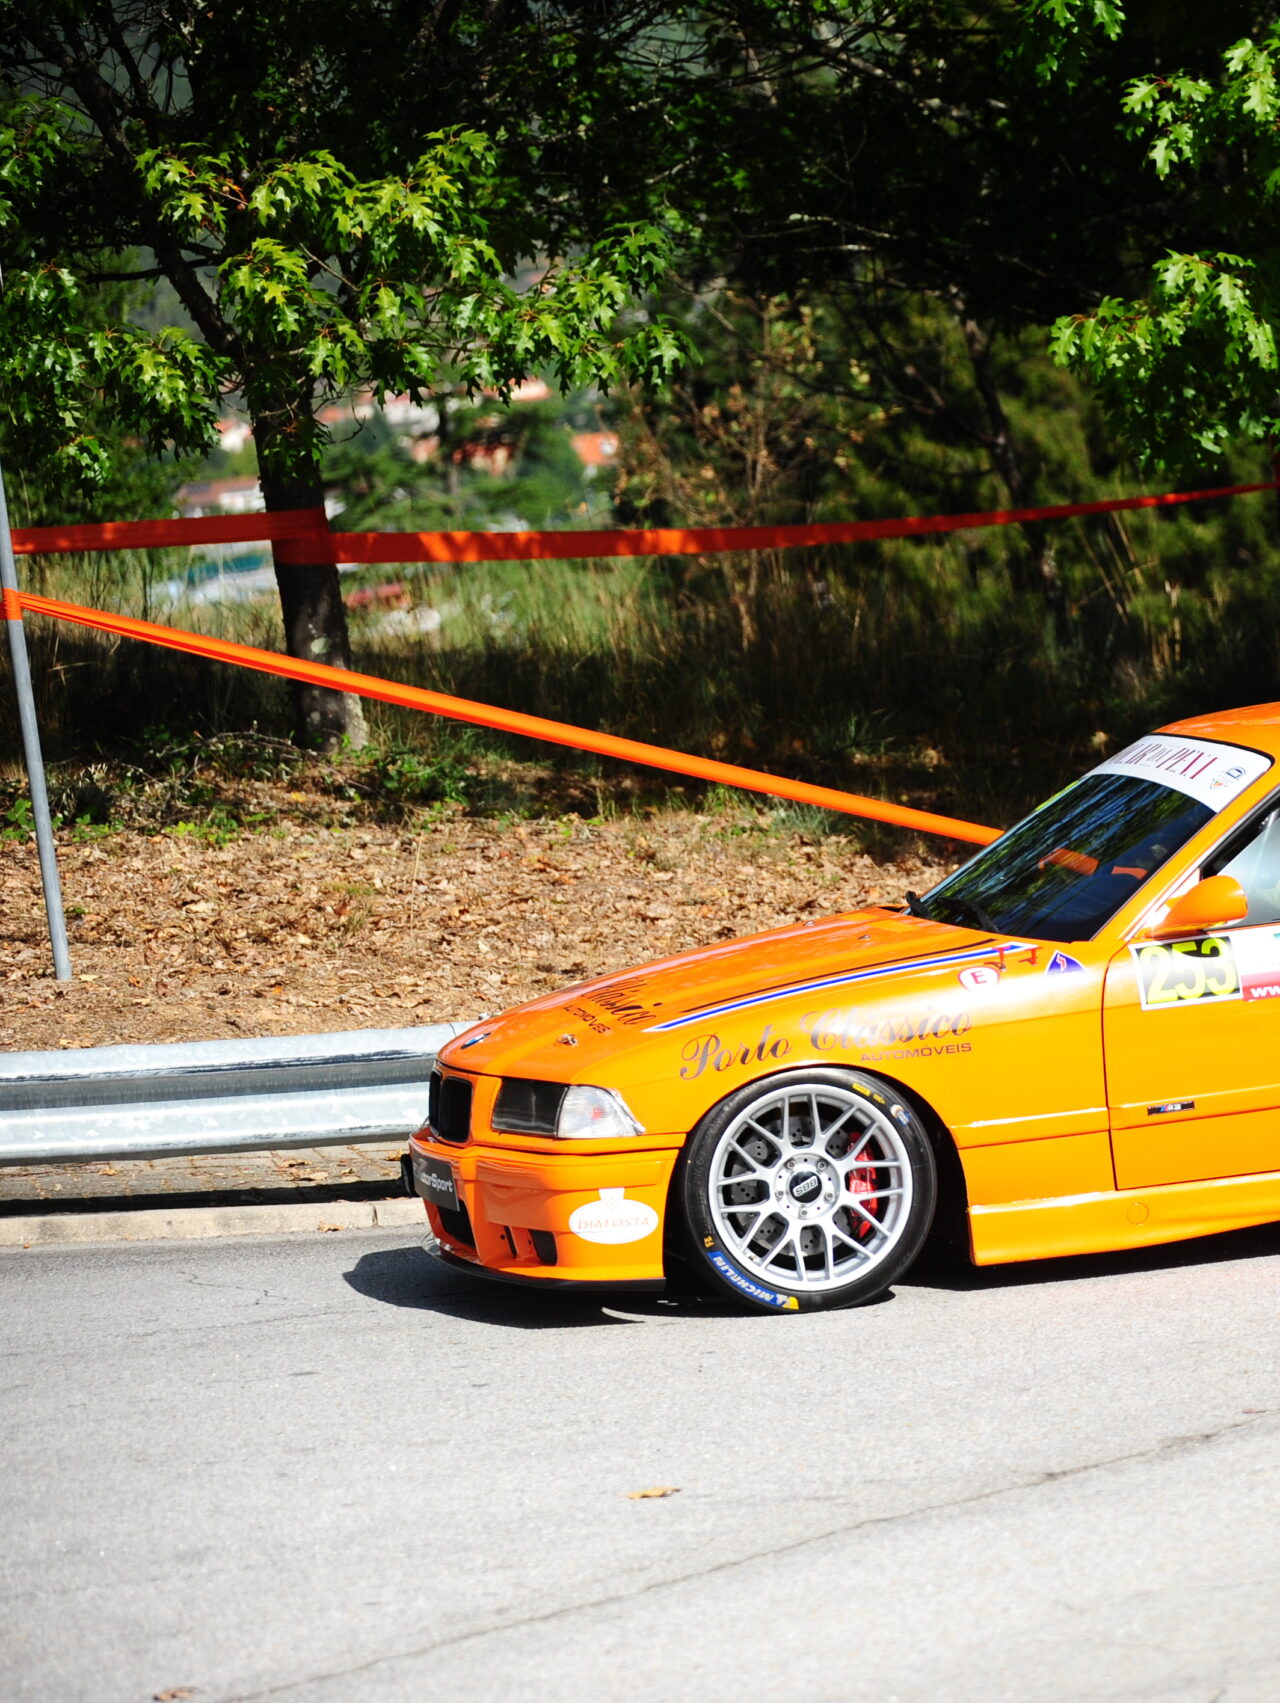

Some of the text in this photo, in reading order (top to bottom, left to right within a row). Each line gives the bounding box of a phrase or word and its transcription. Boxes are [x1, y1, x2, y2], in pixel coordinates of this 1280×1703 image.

[1139, 937, 1238, 1004] 253
[680, 1023, 793, 1081] Porto
[860, 1042, 972, 1062] AUTOMÓVEIS
[795, 1178, 817, 1196] BBS
[577, 1216, 651, 1230] DIATOSTA
[713, 1255, 776, 1302] MICHELIN
